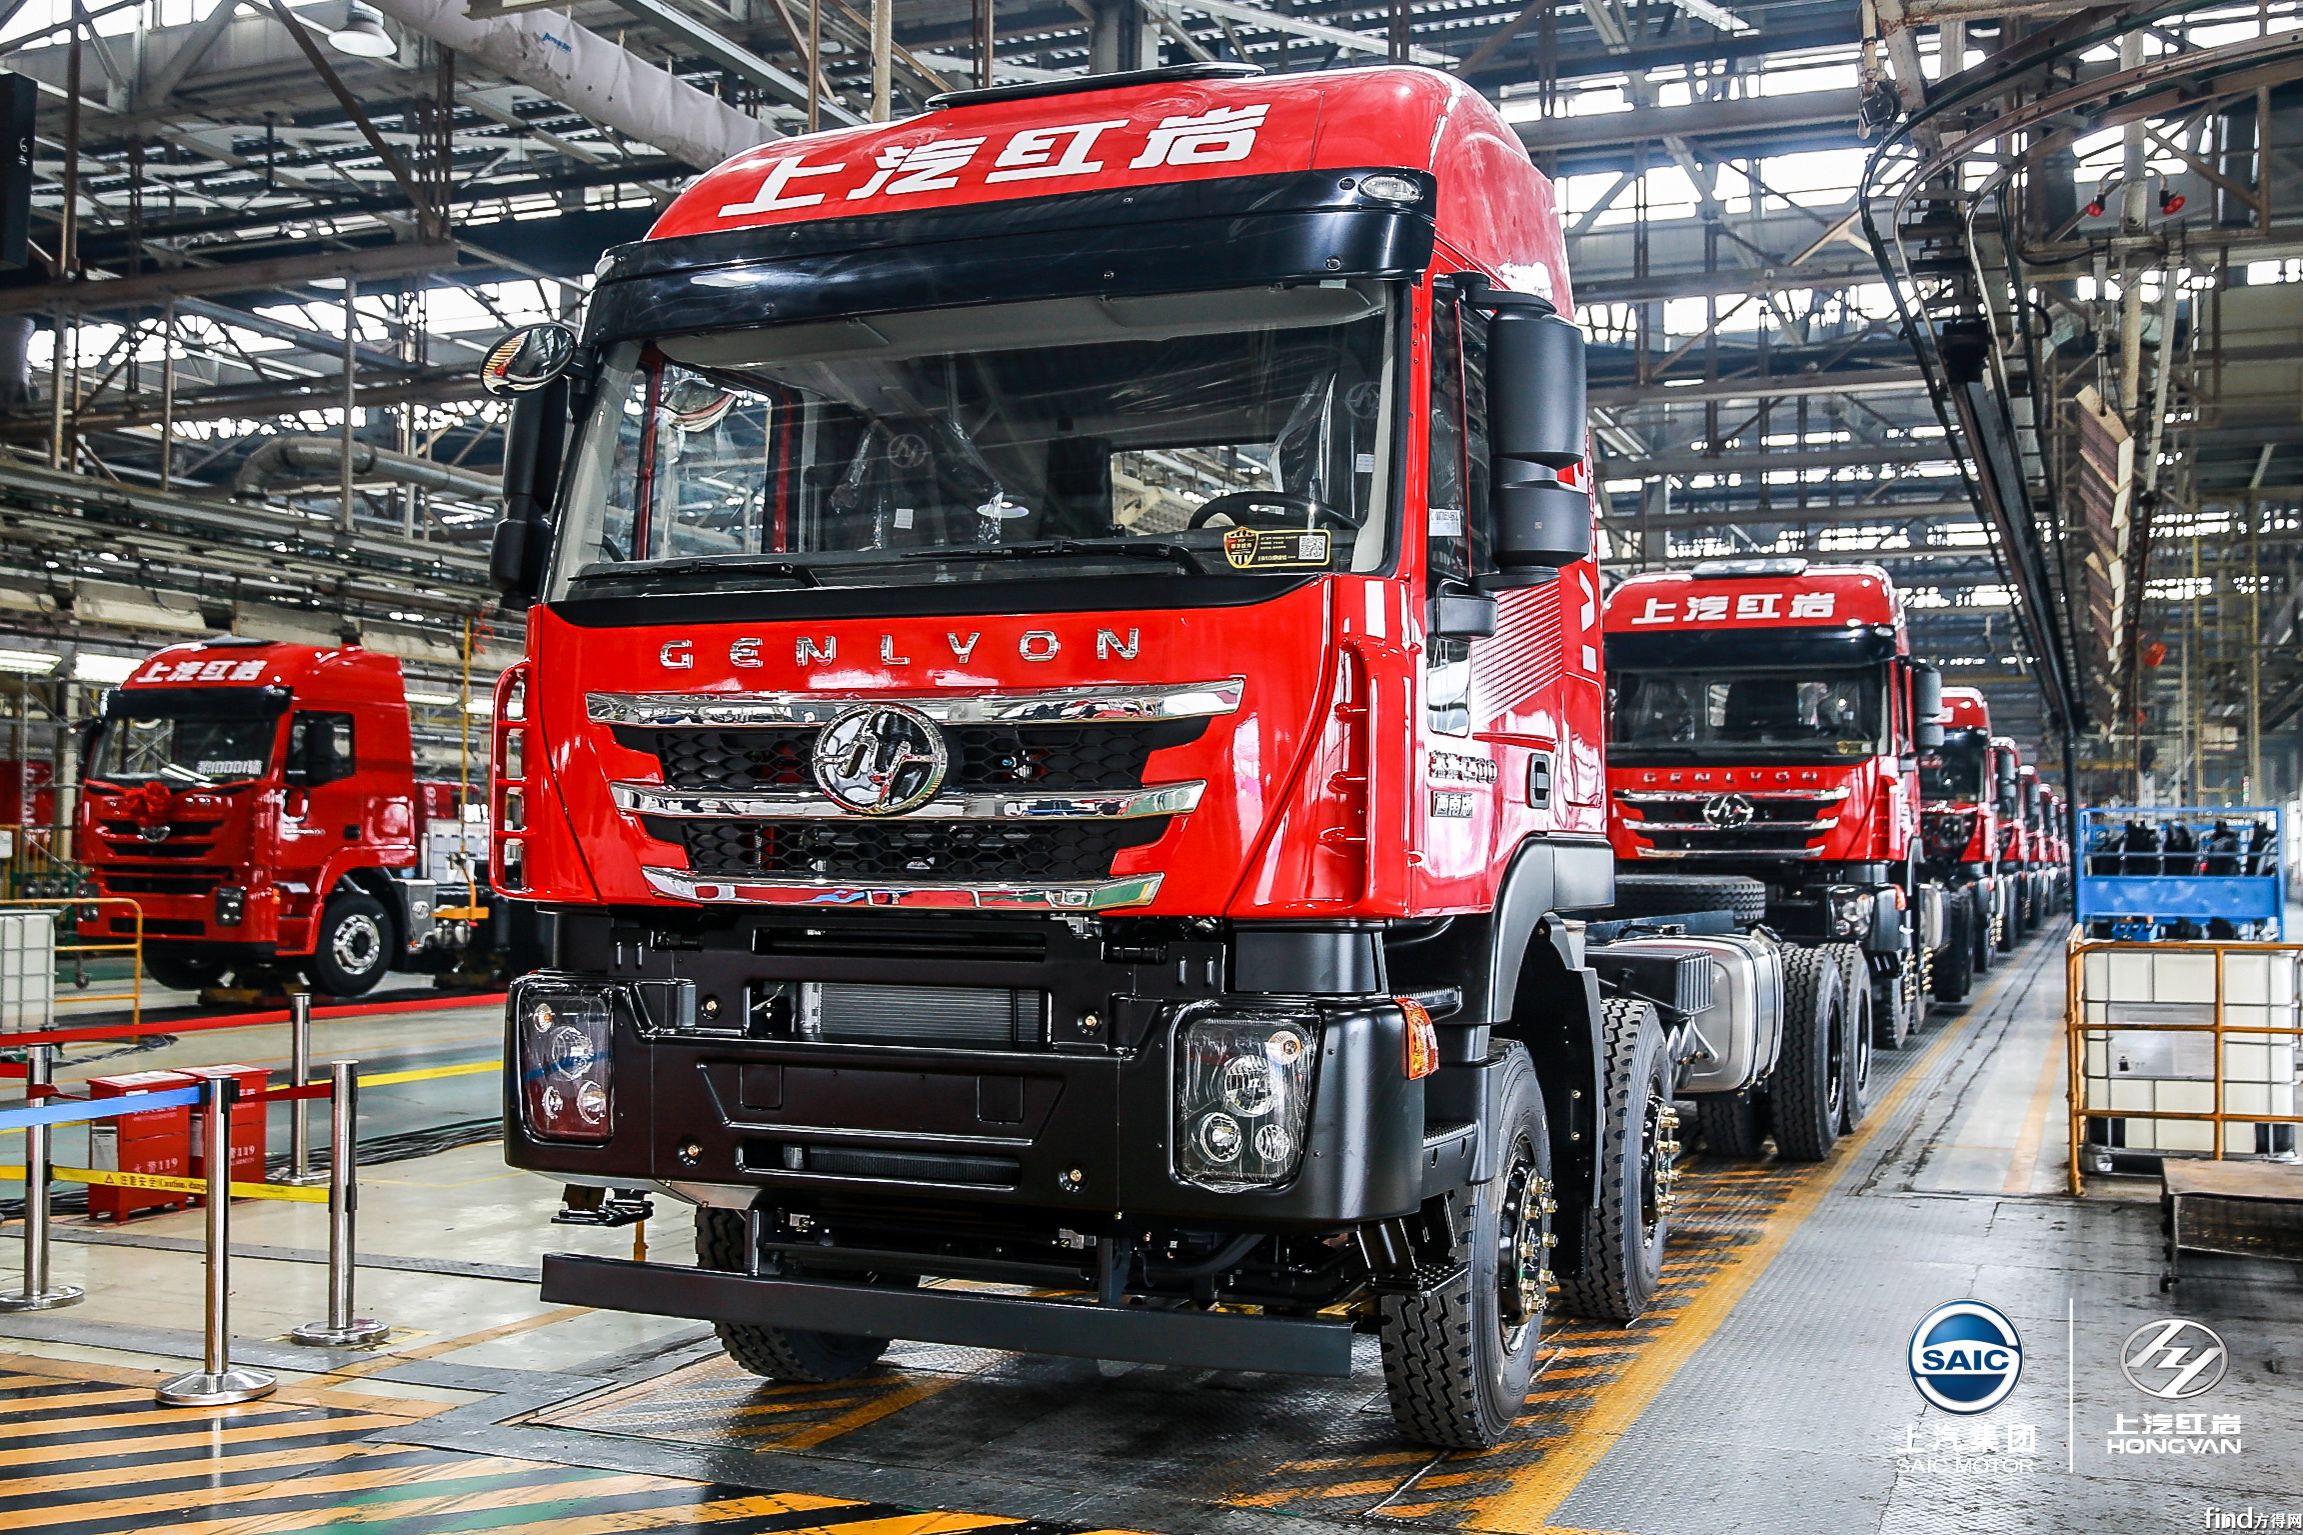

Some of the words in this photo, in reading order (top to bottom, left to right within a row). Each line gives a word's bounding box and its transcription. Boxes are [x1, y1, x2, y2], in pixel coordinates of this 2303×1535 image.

[717, 103, 1272, 218] 上汽红岩
[1631, 592, 1836, 625] 上汽红岩
[659, 627, 1140, 669] GENLYON
[136, 660, 267, 683] 上汽红岩
